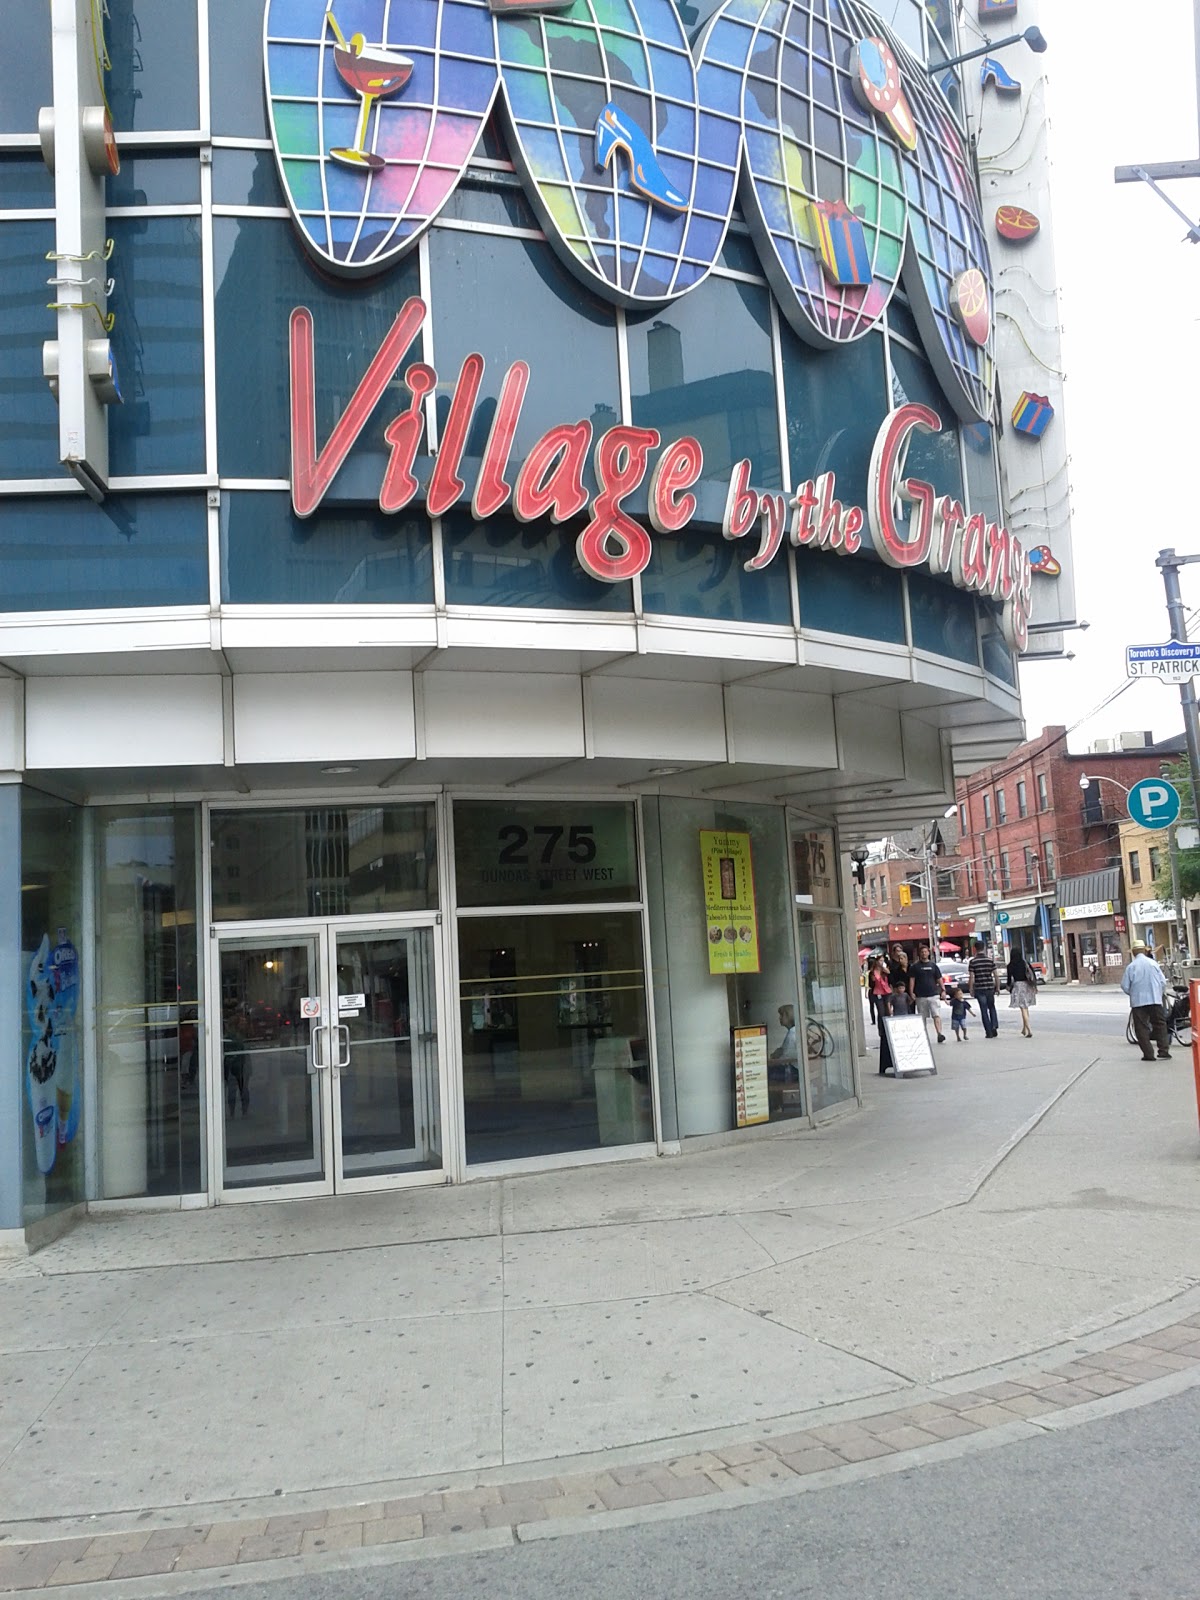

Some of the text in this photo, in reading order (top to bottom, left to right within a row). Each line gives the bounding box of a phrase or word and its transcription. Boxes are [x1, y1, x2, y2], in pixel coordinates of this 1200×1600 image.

[289, 295, 1033, 652] Village by the Grange
[1129, 648, 1159, 658] Toronto's
[1161, 646, 1194, 657] Discovery
[1130, 660, 1199, 675] ST. PATRICK
[1139, 786, 1169, 816] P
[498, 825, 596, 864] 275
[481, 867, 615, 883] DUNDAS STREET WEST
[1066, 905, 1086, 916] SUSHI
[1093, 903, 1107, 913] BBQ
